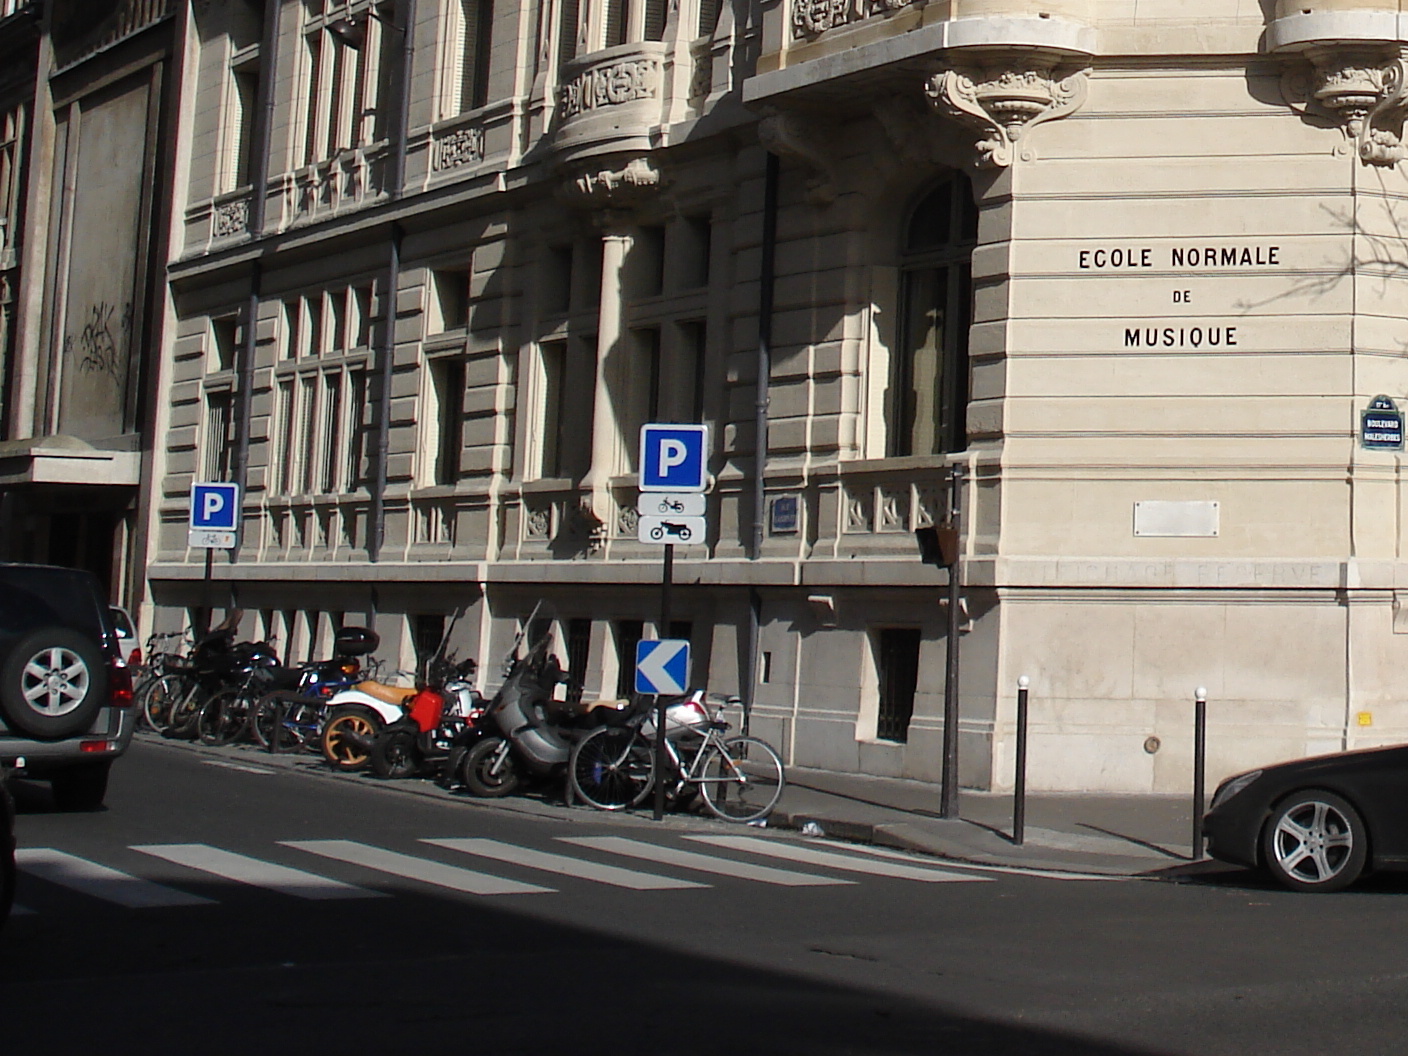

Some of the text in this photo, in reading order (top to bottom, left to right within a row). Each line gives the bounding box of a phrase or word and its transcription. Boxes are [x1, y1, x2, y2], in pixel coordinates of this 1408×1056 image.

[1079, 246, 1280, 268] ECOLE NORMALE
[1173, 290, 1191, 303] DE
[1124, 327, 1237, 348] MUSIQUE
[658, 438, 688, 478] P
[203, 492, 224, 521] P
